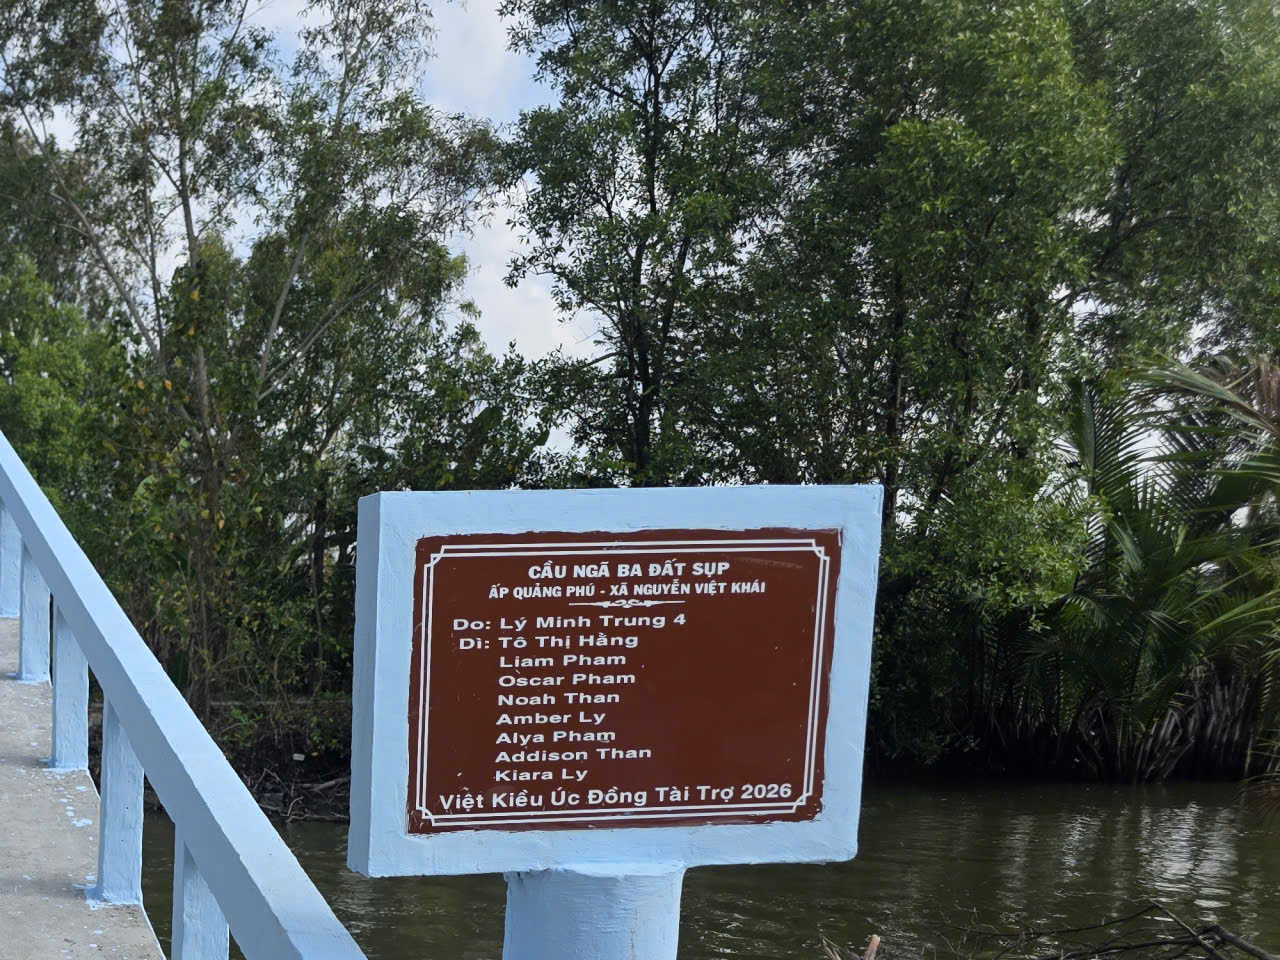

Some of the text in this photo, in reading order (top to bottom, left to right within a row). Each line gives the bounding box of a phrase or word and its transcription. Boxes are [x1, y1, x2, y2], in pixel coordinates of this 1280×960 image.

[528, 558, 731, 579] CẦU NGÃ BA ĐẤT SỤP
[488, 583, 510, 599] ẤP
[513, 582, 562, 600] QUẢNG
[565, 582, 596, 597] PHÚ
[609, 581, 629, 596] XÃ
[633, 578, 691, 595] NGUYỄN
[694, 580, 727, 596] VIỆT
[730, 578, 767, 594] KHÁI
[452, 613, 687, 632] Do: Lý Minh Trung 4
[458, 631, 639, 650] Dì: Tô Thị Hằng
[499, 654, 627, 668] Liam Pham
[497, 672, 636, 687] Oscar Pham
[497, 692, 620, 706] Noah Than
[495, 711, 606, 726] Amber Ly
[495, 730, 616, 746] Alya Pham
[494, 747, 652, 764] Addison Than
[495, 767, 589, 782] Kiara Ly
[439, 783, 793, 812] Việt Kiều Úc Đồng Tài Trợ 2026
